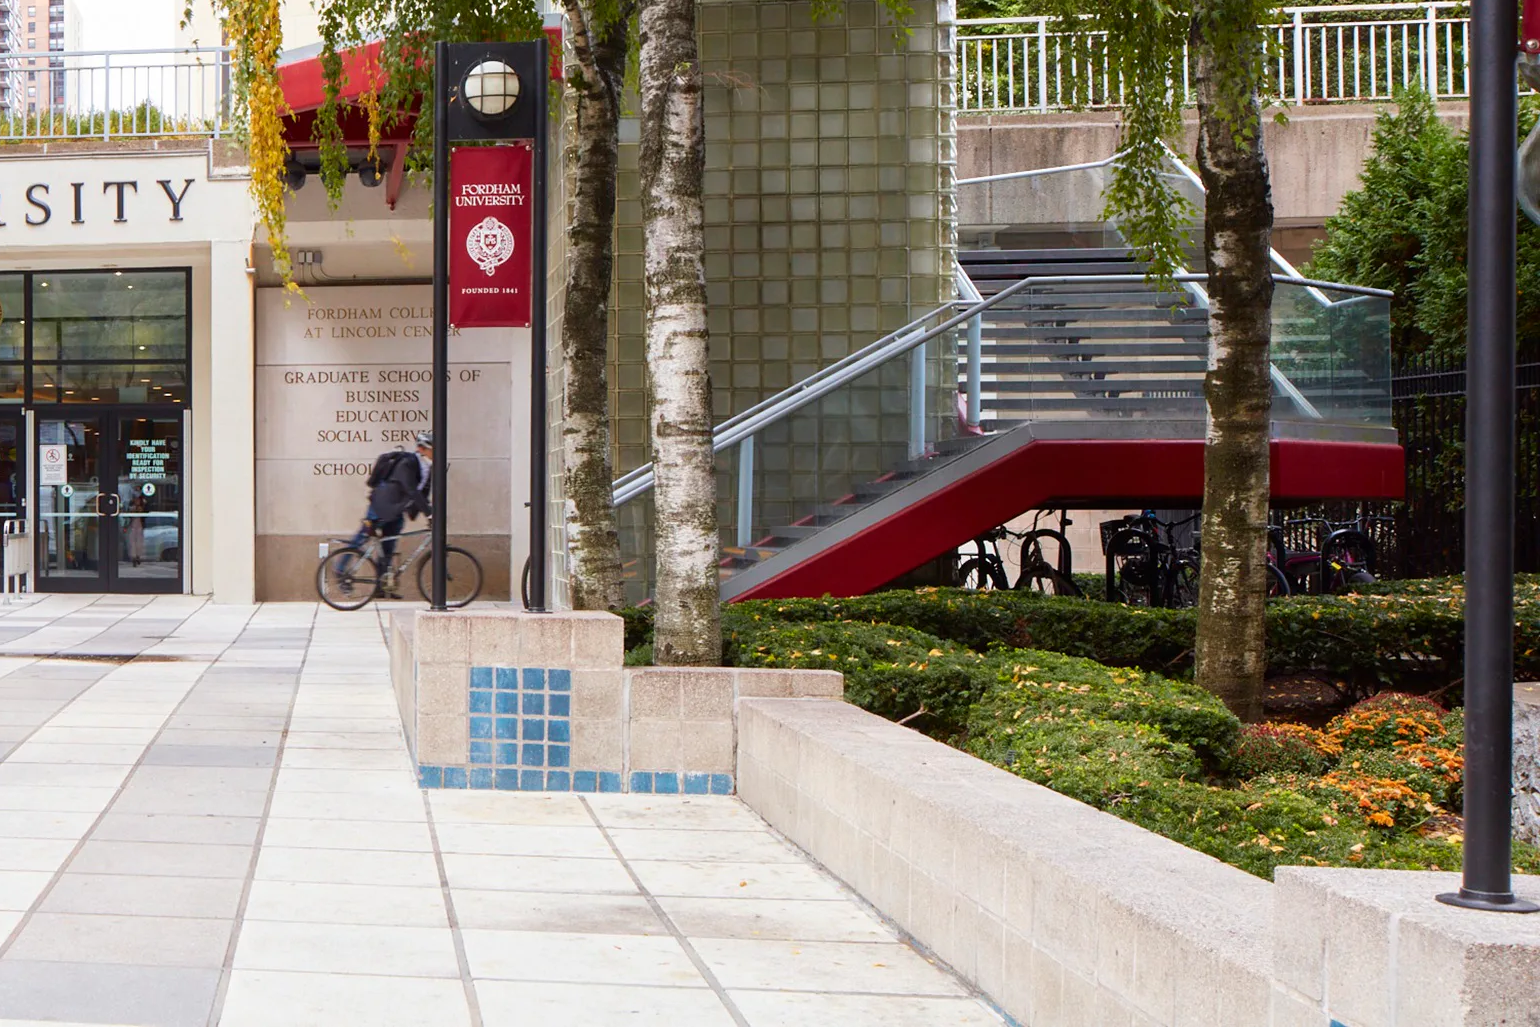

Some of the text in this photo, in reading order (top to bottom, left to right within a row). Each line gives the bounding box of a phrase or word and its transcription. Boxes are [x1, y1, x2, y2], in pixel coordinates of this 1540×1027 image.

[461, 183, 521, 196] FORDHAM
[455, 195, 525, 207] UNIVERSITY
[461, 287, 500, 295] FOUNDED
[307, 306, 433, 320] FORDHAM COLL
[304, 327, 323, 339] AT
[331, 325, 397, 339] LINCOLN
[284, 369, 481, 384] GRADUATE SCHOOS OF
[346, 390, 420, 403] BUSINESS
[335, 409, 429, 423] EDUCATION
[317, 429, 373, 443] SOCIAL
[313, 463, 373, 476] SCHOOL
